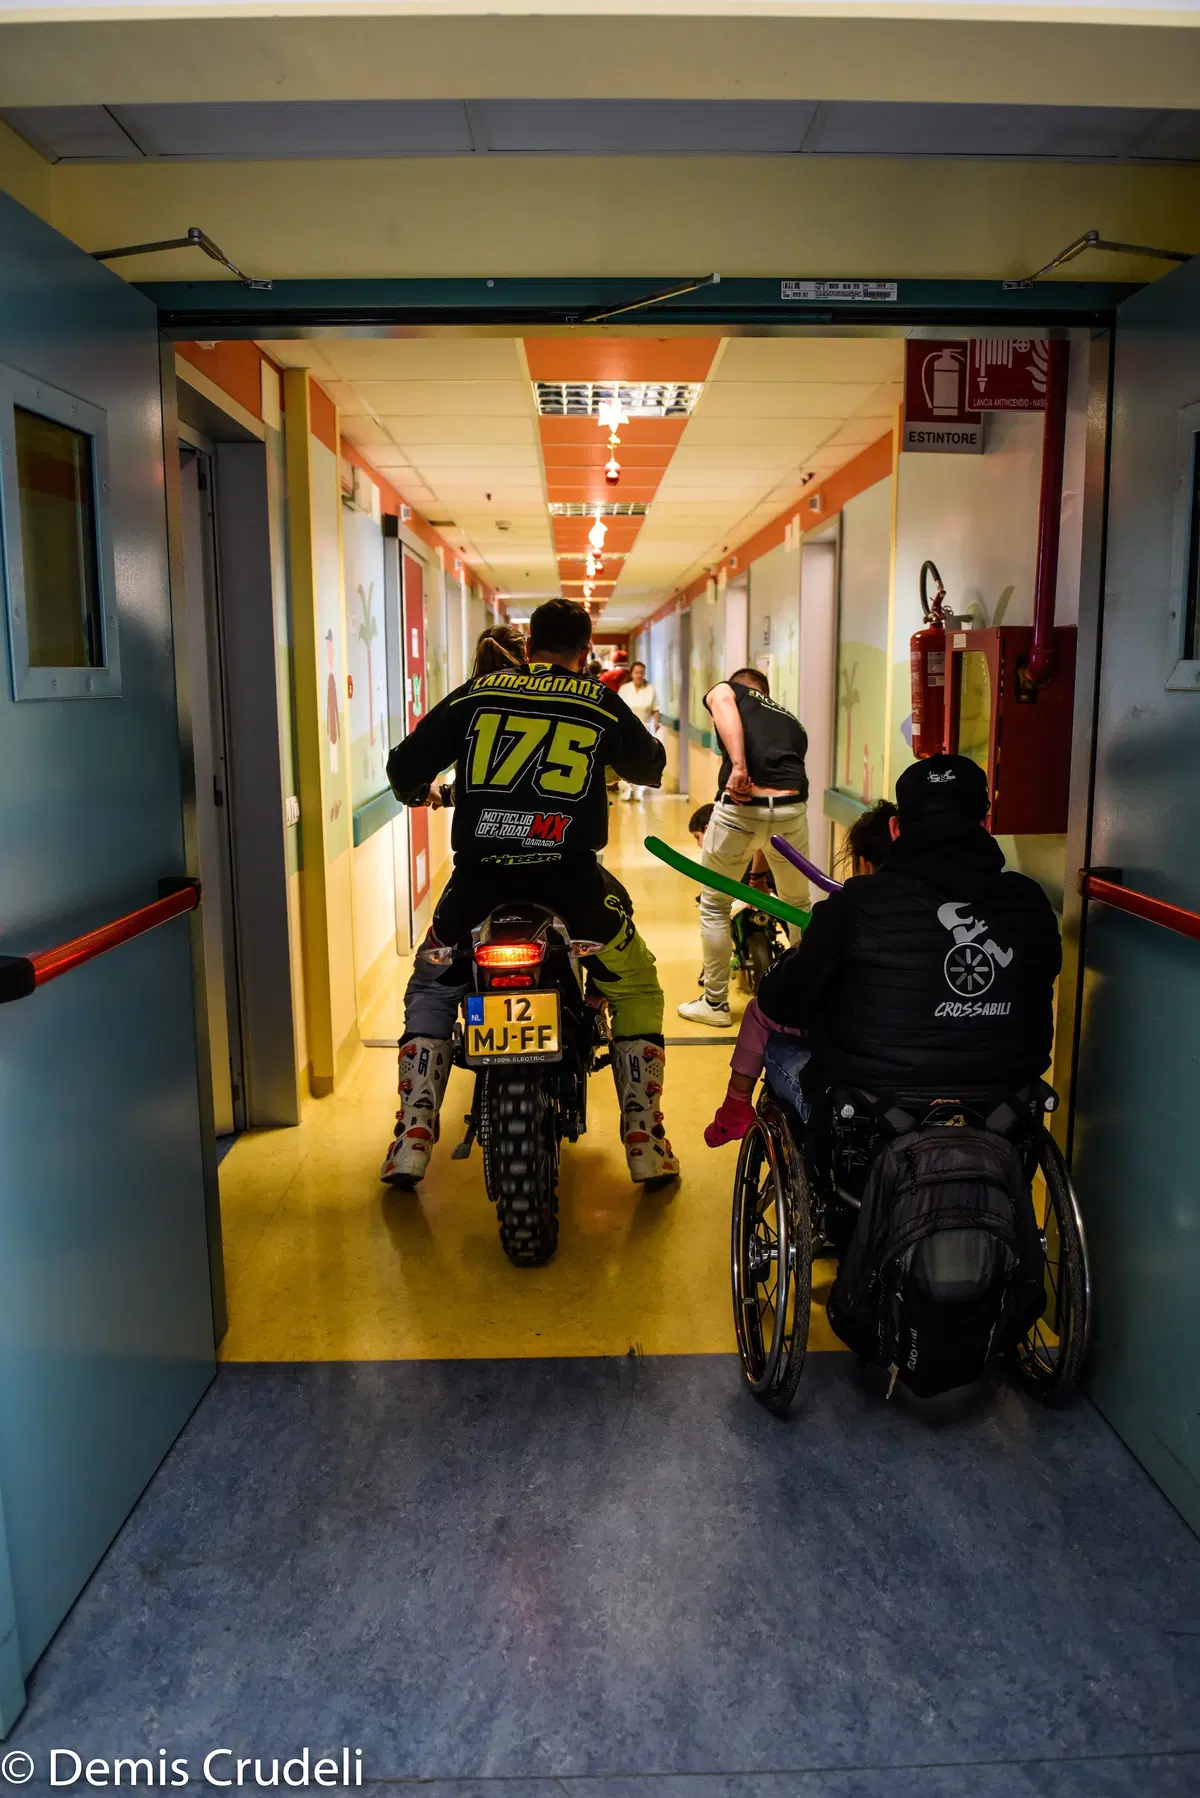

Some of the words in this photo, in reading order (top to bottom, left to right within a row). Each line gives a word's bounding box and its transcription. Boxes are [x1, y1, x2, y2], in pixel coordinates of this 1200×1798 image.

[973, 398, 993, 407] LANCIA
[994, 398, 1029, 408] ANTINCENDIO
[908, 431, 978, 445] ESTINTORE
[471, 713, 598, 795] 175
[481, 810, 534, 825] MOTOCLUB
[477, 822, 498, 837] OFF
[498, 823, 531, 838] ROAD
[529, 813, 571, 842] MX
[525, 837, 555, 847] DAIRAGO
[503, 997, 532, 1022] 12
[934, 1001, 1011, 1017] CROSSABILI
[471, 1014, 482, 1022] NL
[473, 1025, 552, 1052] MJ-FF
